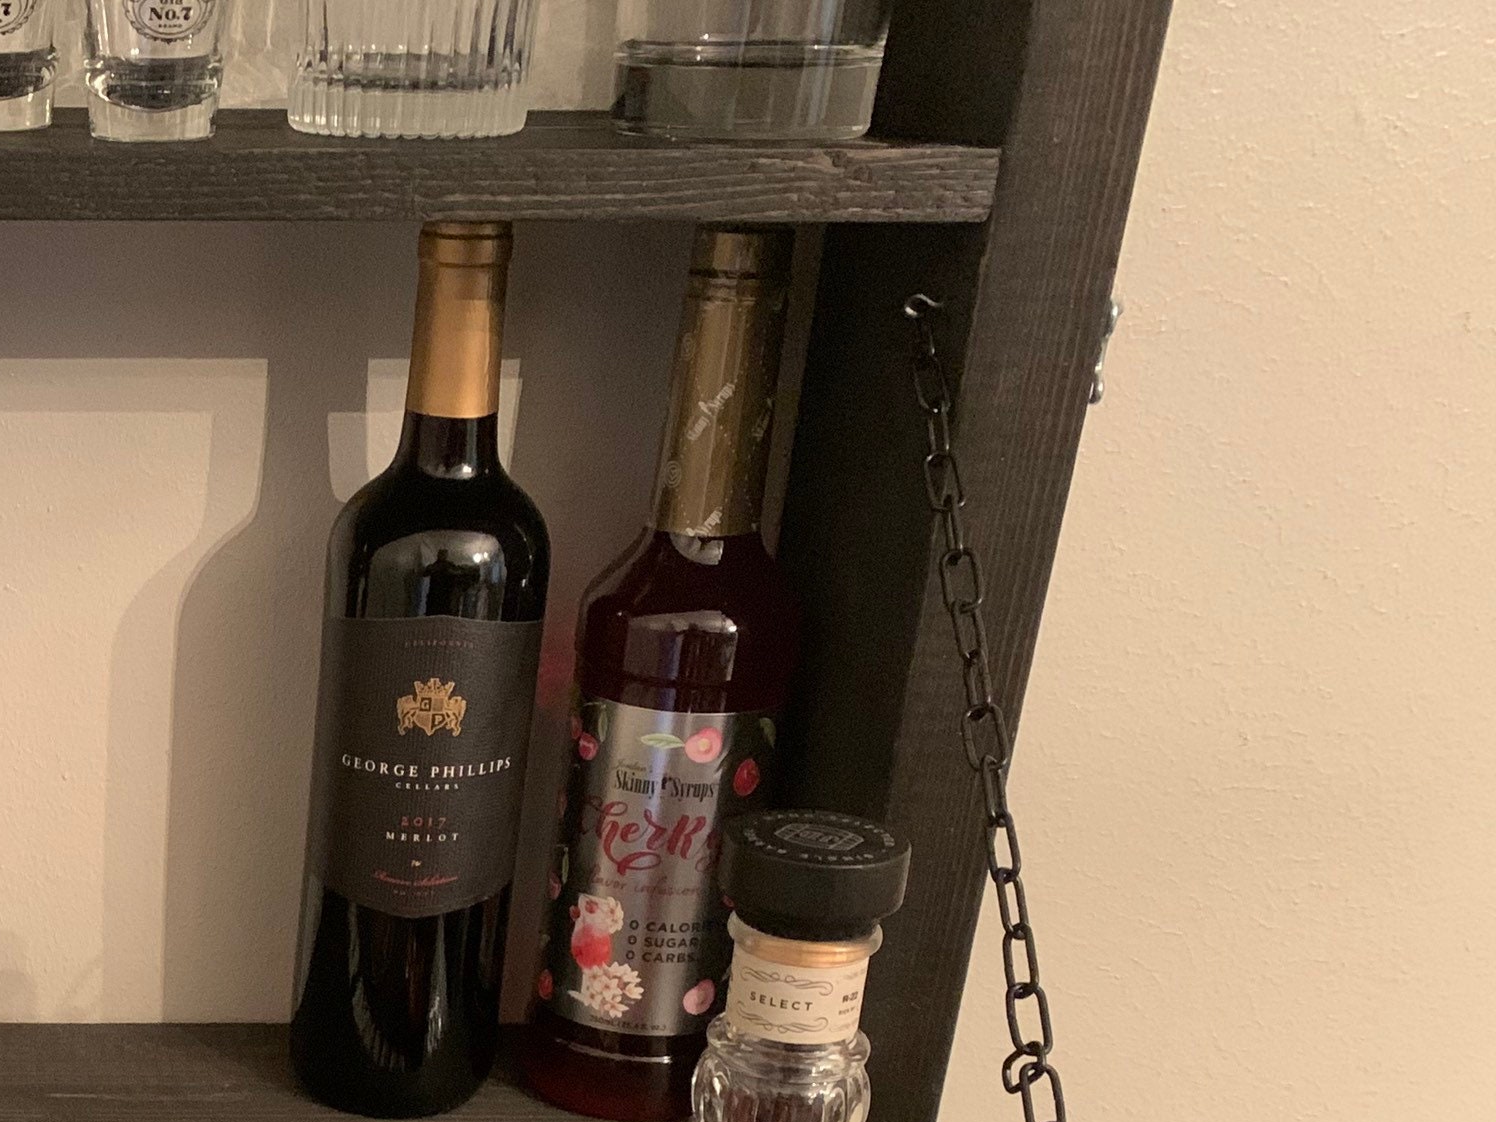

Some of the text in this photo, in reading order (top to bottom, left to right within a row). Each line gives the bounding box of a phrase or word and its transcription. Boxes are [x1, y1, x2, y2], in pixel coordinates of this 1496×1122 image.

[149, 7, 192, 21] No.7
[342, 754, 511, 778] GEORGE PHILLIPS
[395, 782, 459, 790] CELLARS
[614, 769, 655, 799] Skinny
[401, 816, 446, 829] 2017
[386, 831, 459, 842] MERLOT
[749, 991, 814, 1012] SELECT
